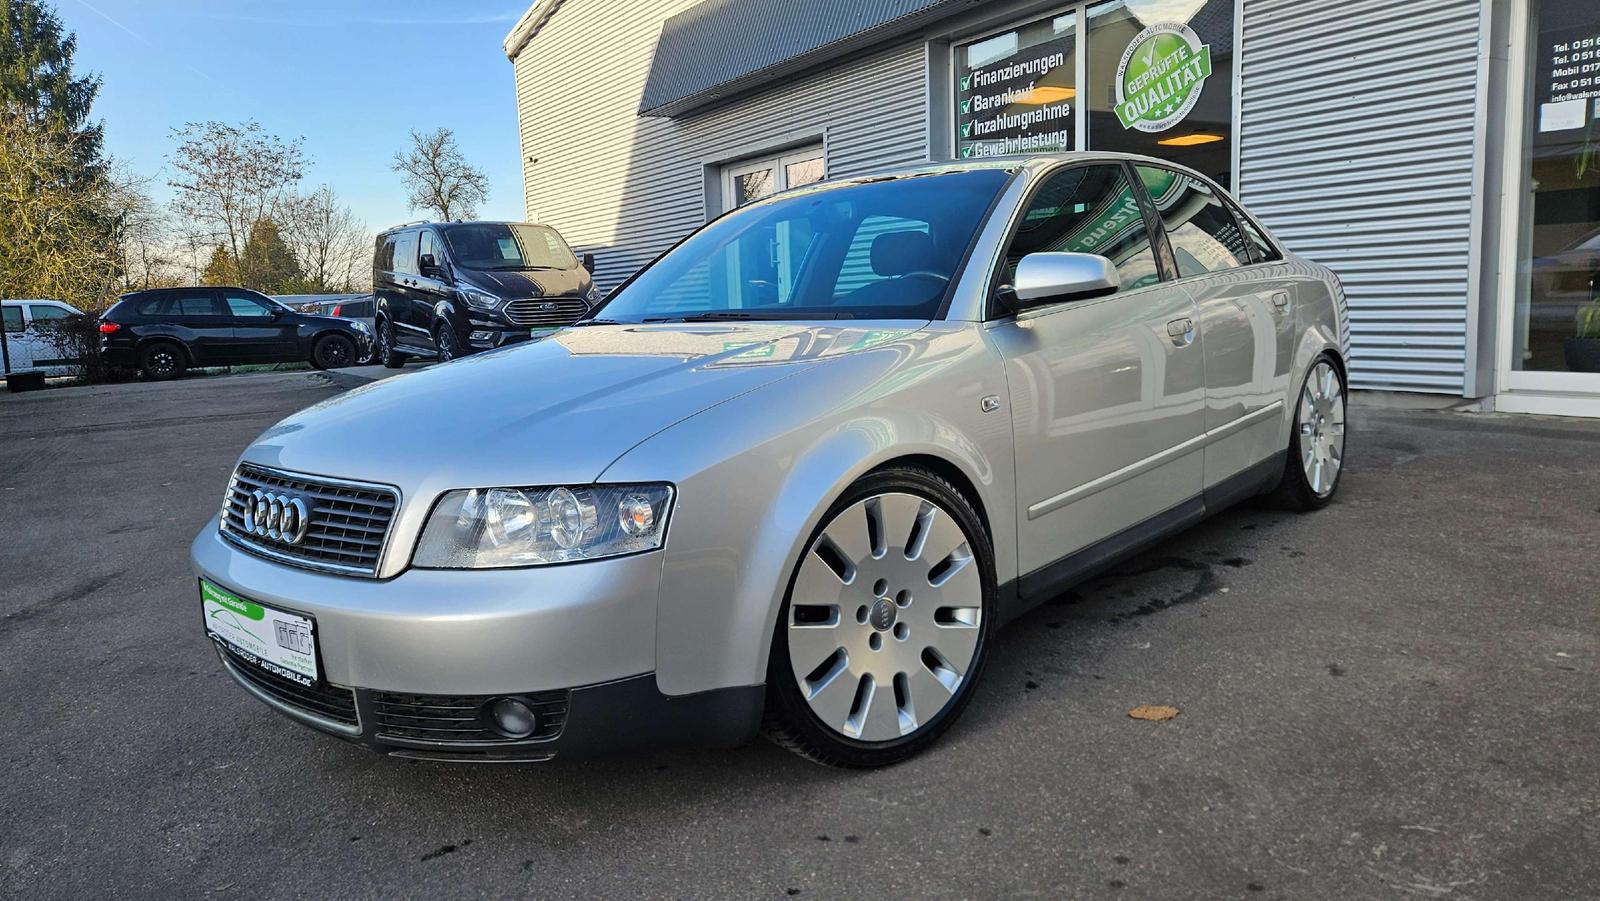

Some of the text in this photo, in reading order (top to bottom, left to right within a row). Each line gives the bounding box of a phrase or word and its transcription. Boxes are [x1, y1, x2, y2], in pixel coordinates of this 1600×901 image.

[1552, 55, 1570, 64] Tel.
[1572, 53, 1580, 61] 0
[1553, 43, 1570, 52] Tel.
[1573, 40, 1580, 49] 0
[973, 52, 1064, 87] Finanzierungen
[1127, 45, 1189, 94] GEPRÜFTE
[1552, 66, 1579, 77] Mobil
[974, 80, 1035, 111] Barankauf
[1124, 55, 1204, 122] QUALITÄT
[1552, 82, 1569, 91] Fax
[1571, 80, 1579, 88] 0
[974, 103, 1070, 135] Inzahlungnahme
[974, 129, 1068, 157] Gewährleistung
